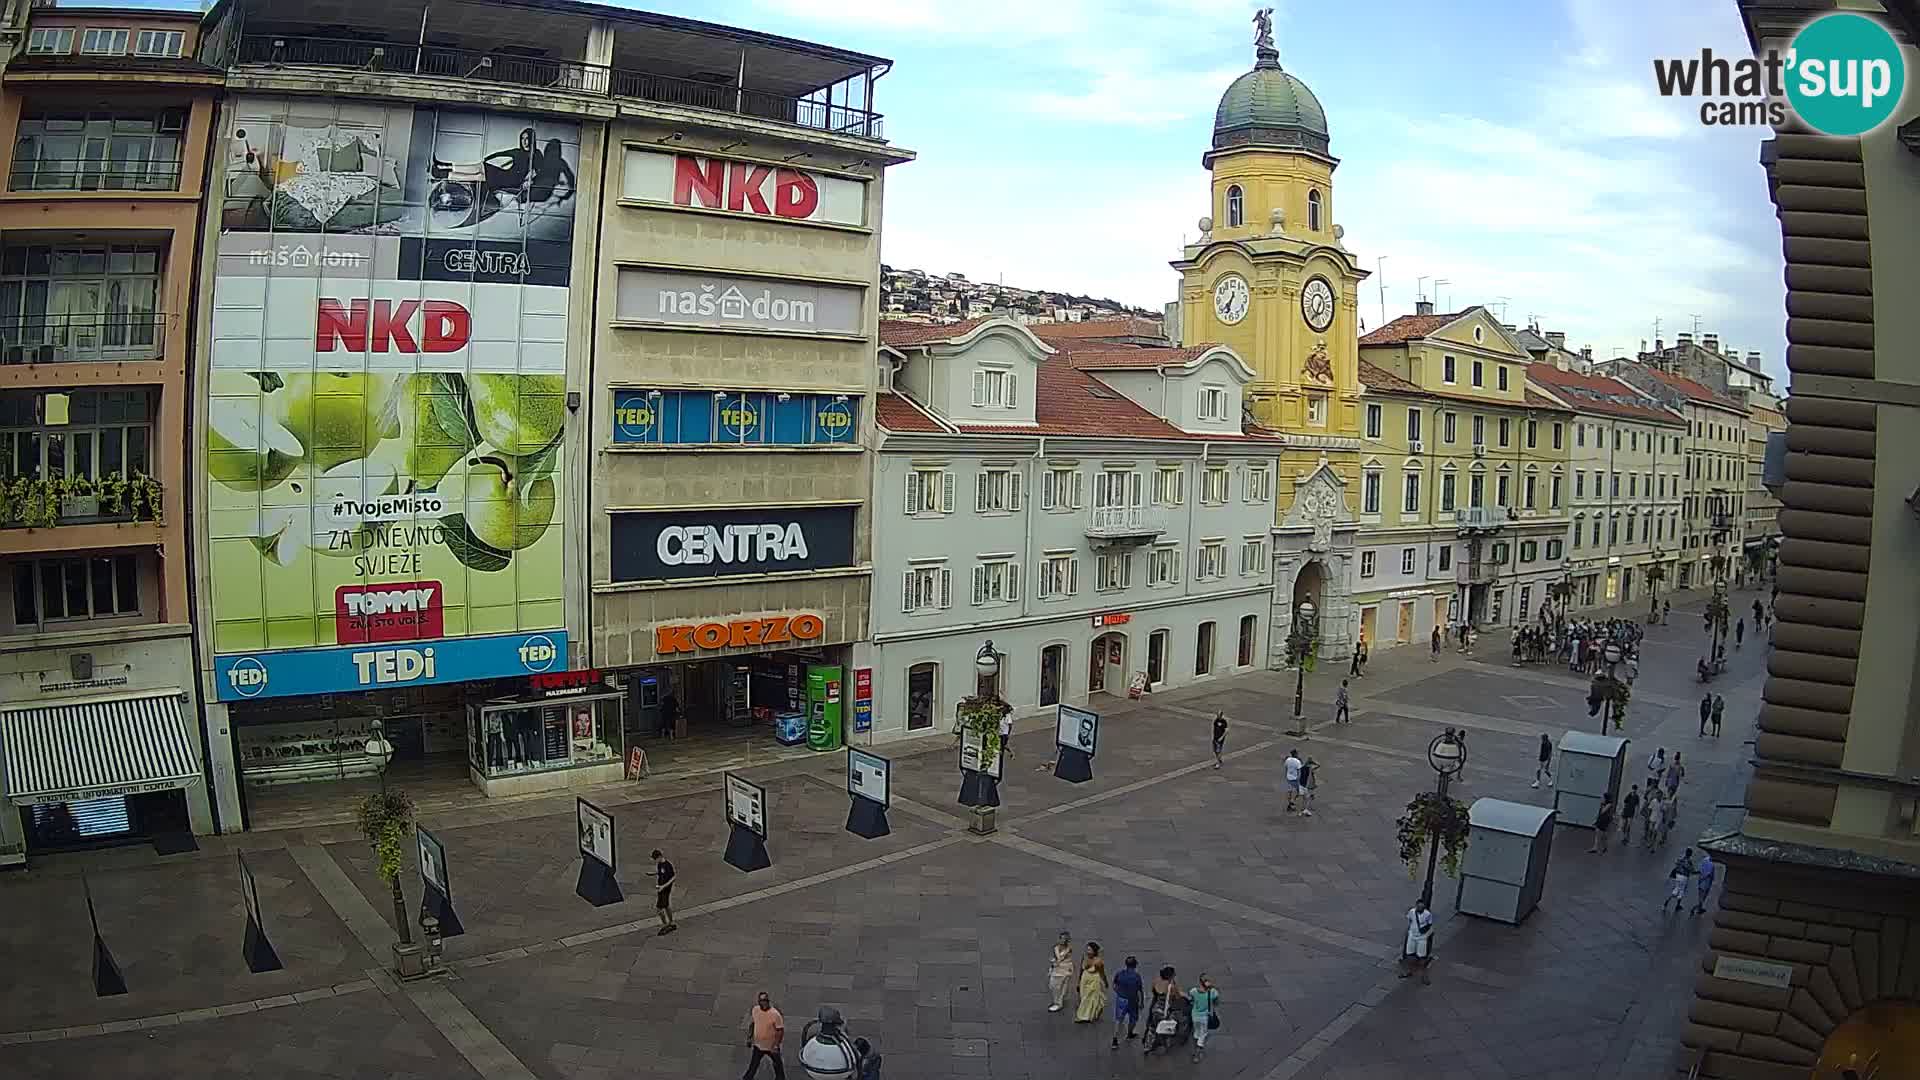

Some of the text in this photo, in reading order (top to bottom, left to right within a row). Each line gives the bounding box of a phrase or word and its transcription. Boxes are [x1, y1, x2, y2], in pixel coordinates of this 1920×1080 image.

[674, 155, 819, 220] NKD
[249, 245, 361, 268] naš dom
[444, 249, 531, 275] CENTRA
[659, 284, 815, 323] naš dom
[315, 297, 472, 354] NKD
[616, 409, 655, 426] TEDi
[721, 409, 758, 426] TEDi
[818, 411, 851, 427] TEDi
[333, 498, 442, 517] #TvojeMisto
[328, 525, 446, 550] ZA DNEVNO
[657, 522, 808, 566] CENTRA
[354, 549, 422, 577] SVJEŽE
[343, 588, 435, 616] TOMMY
[656, 614, 824, 654] KORZO
[352, 647, 436, 684] TEDi
[519, 643, 557, 664] TEDi
[228, 667, 268, 687] TEDi
